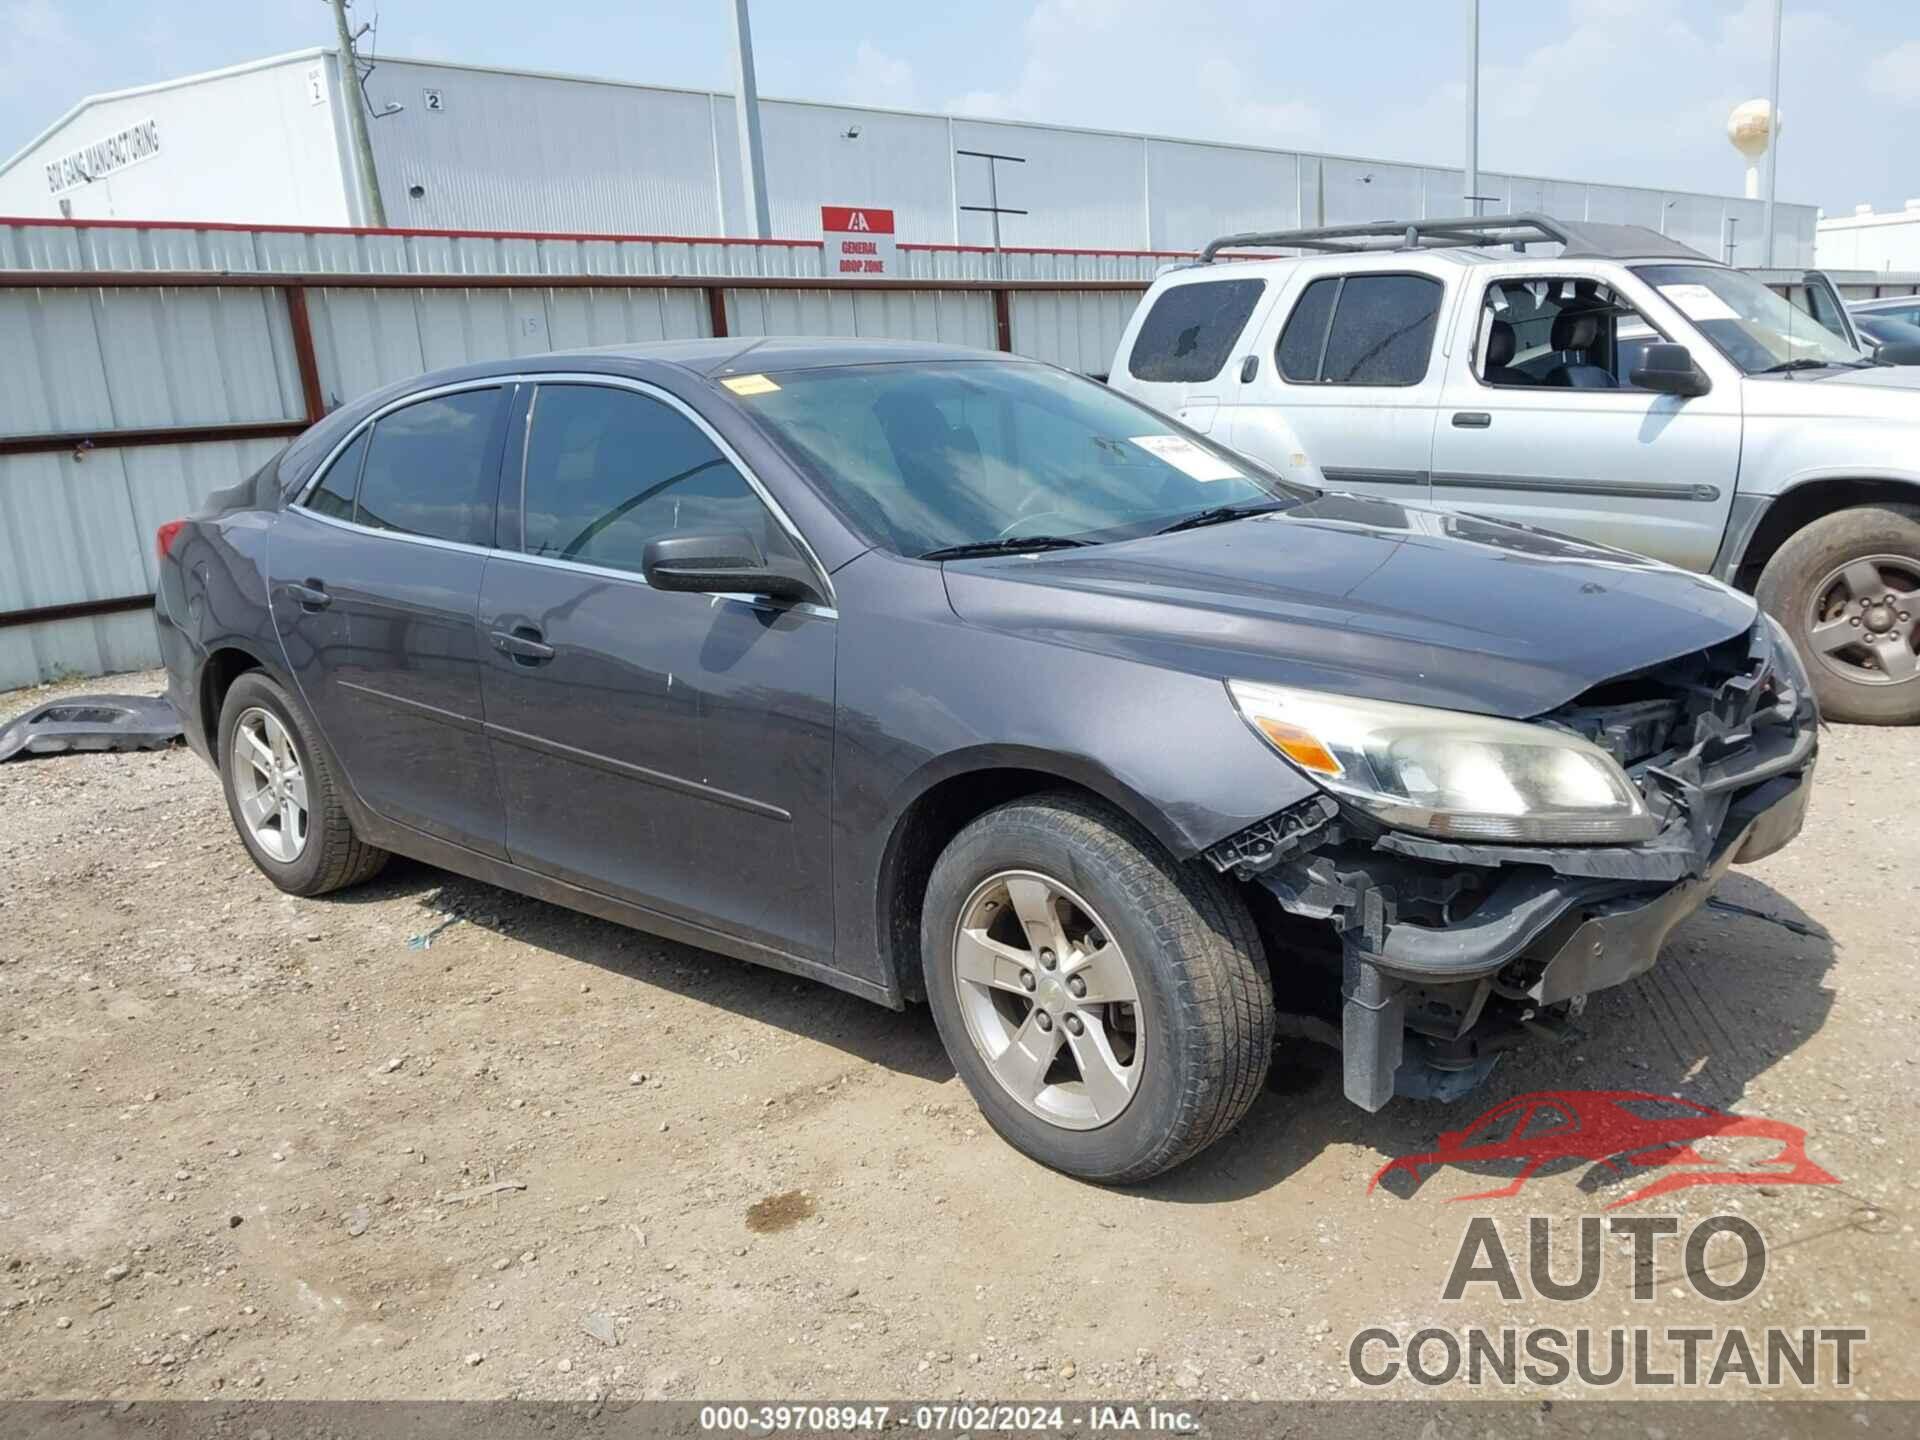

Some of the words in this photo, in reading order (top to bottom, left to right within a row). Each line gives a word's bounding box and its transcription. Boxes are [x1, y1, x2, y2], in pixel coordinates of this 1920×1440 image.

[428, 94, 440, 109] 2
[46, 159, 65, 193] BOX
[84, 119, 159, 177] MANUFACTURING
[842, 241, 877, 255] GENERAL
[839, 259, 863, 273] DROP
[863, 260, 884, 273] ZONE
